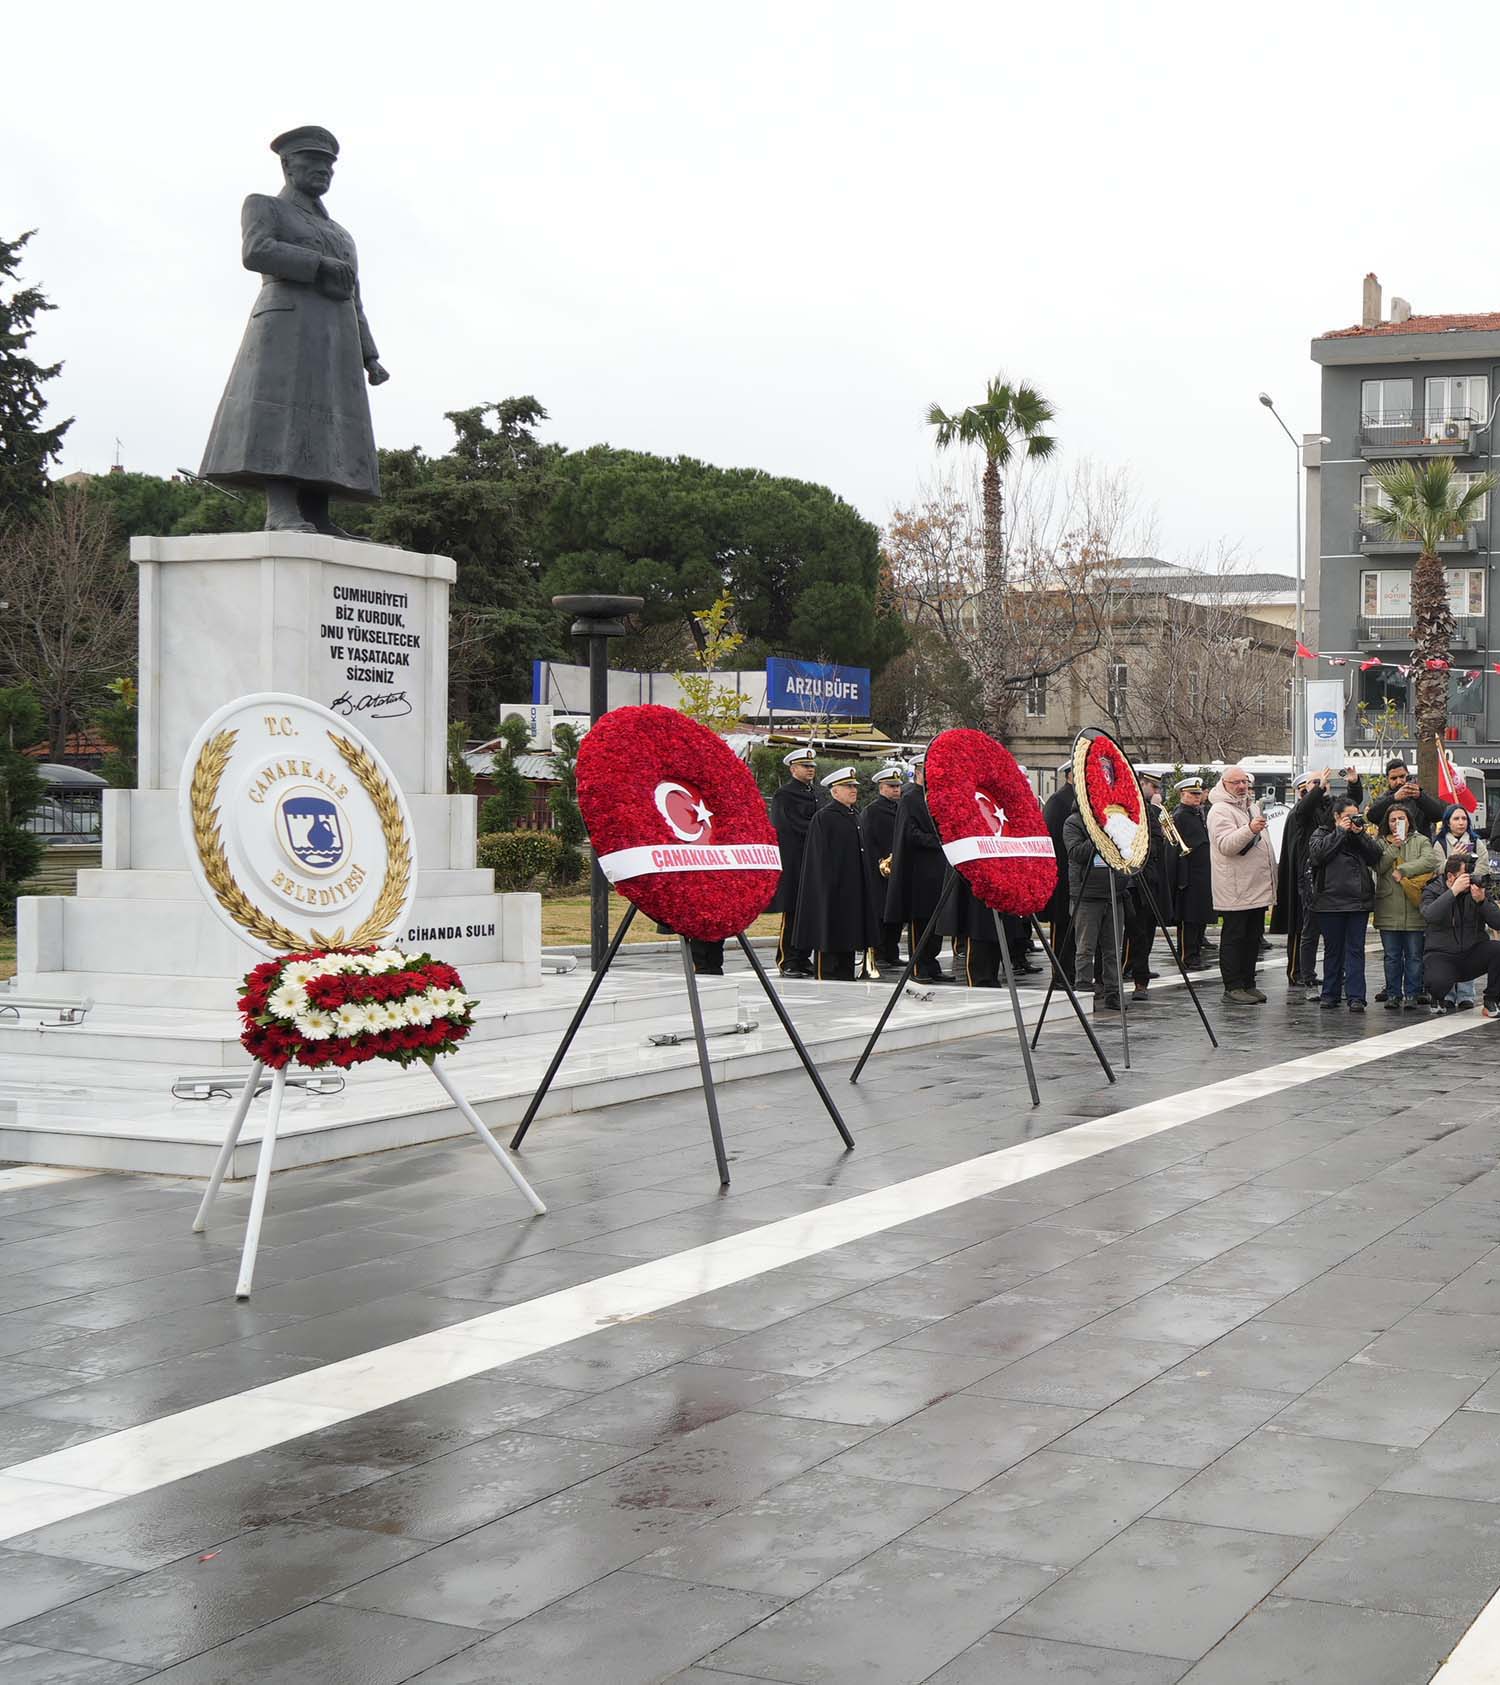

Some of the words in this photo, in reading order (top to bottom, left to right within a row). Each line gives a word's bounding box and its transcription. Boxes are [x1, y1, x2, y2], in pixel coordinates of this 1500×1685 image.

[333, 586, 408, 608] CUMHURİYETİ
[336, 604, 354, 621] BİZ
[357, 608, 405, 629] KURDUK,
[320, 624, 344, 640] ONU
[347, 625, 421, 648] YÜKSELTECEK
[330, 645, 344, 659] VE
[347, 647, 410, 667] YAŞATACAK
[346, 665, 394, 684] SİZSİNİZ
[786, 676, 821, 696] ARZU
[825, 677, 858, 700] BÜFE
[264, 714, 299, 736] T.C.
[248, 759, 349, 803] ÇANAKKALE
[651, 849, 731, 871] ÇANAKKALE
[730, 845, 780, 866] VALİLİĞİ
[271, 863, 367, 906] BELEDİYESİ
[408, 925, 462, 942] CİHANDA
[465, 924, 495, 938] SULH
